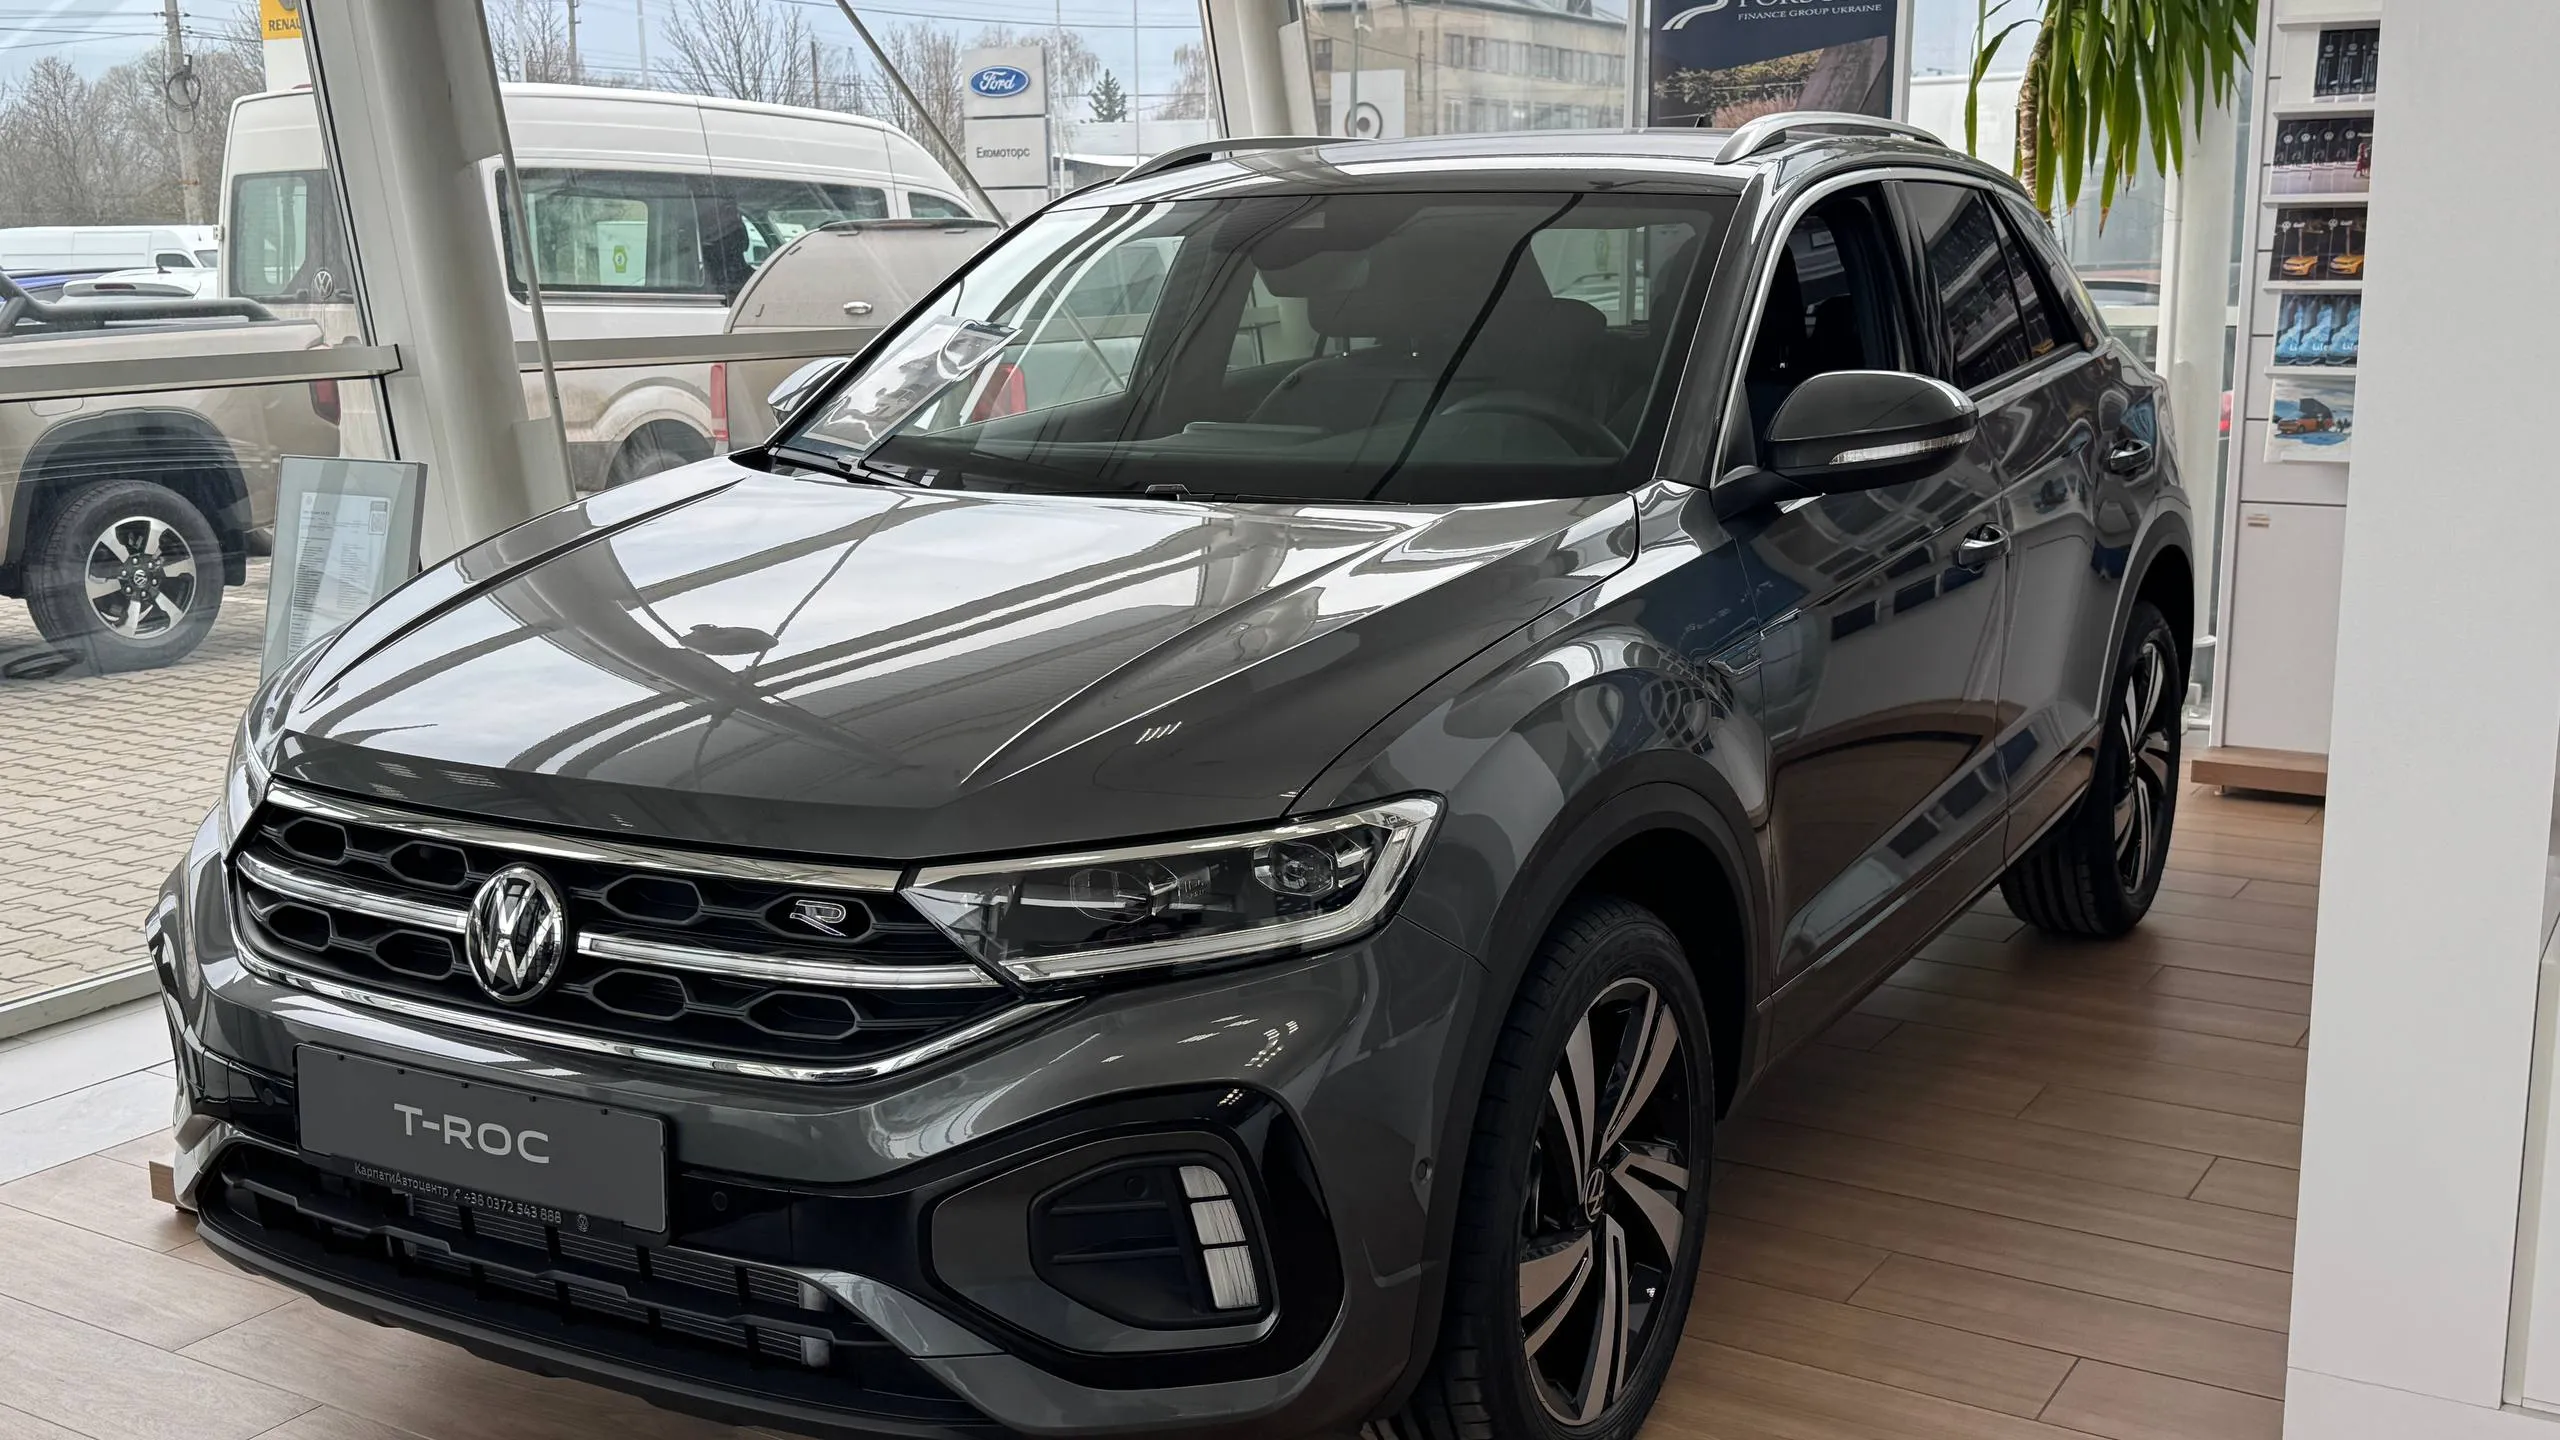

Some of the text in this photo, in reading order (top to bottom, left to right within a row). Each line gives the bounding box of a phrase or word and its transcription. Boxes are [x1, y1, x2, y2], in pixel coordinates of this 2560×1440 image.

[1738, 10, 1787, 21] FINANCE
[1788, 8, 1829, 17] GROUP
[1831, 4, 1882, 15] UKRAINE
[268, 18, 302, 31] RENAU
[980, 70, 1016, 91] Ford
[393, 1102, 550, 1164] T-ROC
[516, 1202, 538, 1219] 543
[540, 1207, 562, 1224] 888
